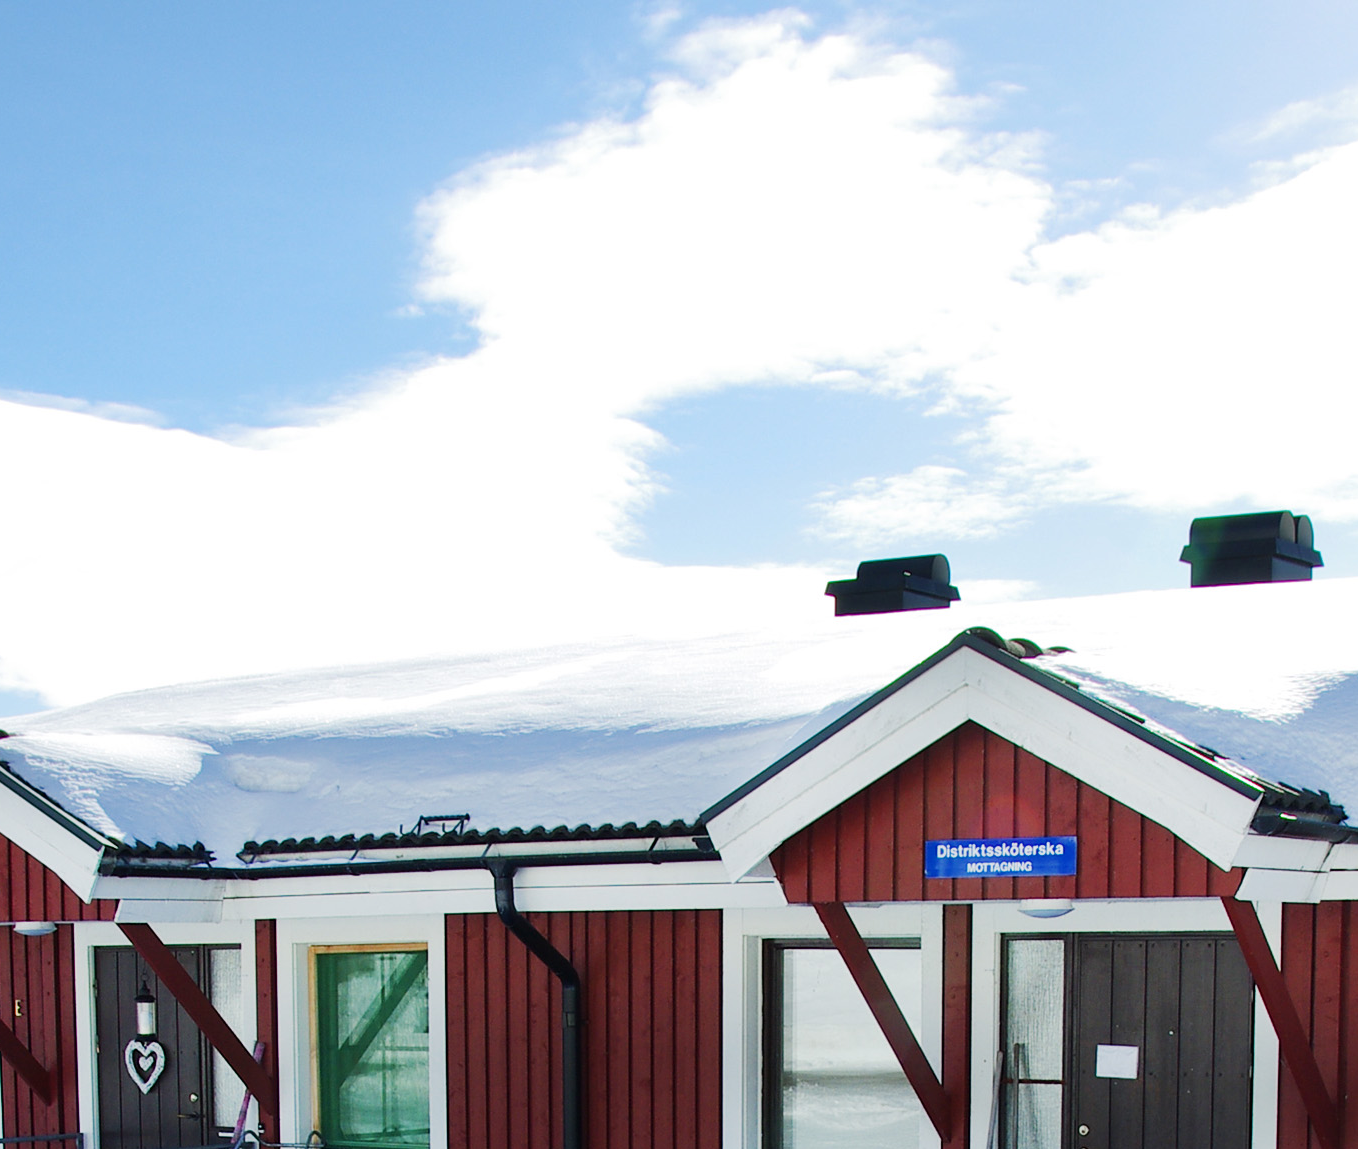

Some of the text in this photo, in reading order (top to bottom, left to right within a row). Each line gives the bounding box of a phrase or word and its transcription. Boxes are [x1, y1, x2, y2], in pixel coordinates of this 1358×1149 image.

[936, 842, 1064, 858] Distriktssköterska
[966, 861, 1033, 873] MOTTAGNING
[14, 999, 23, 1017] E
